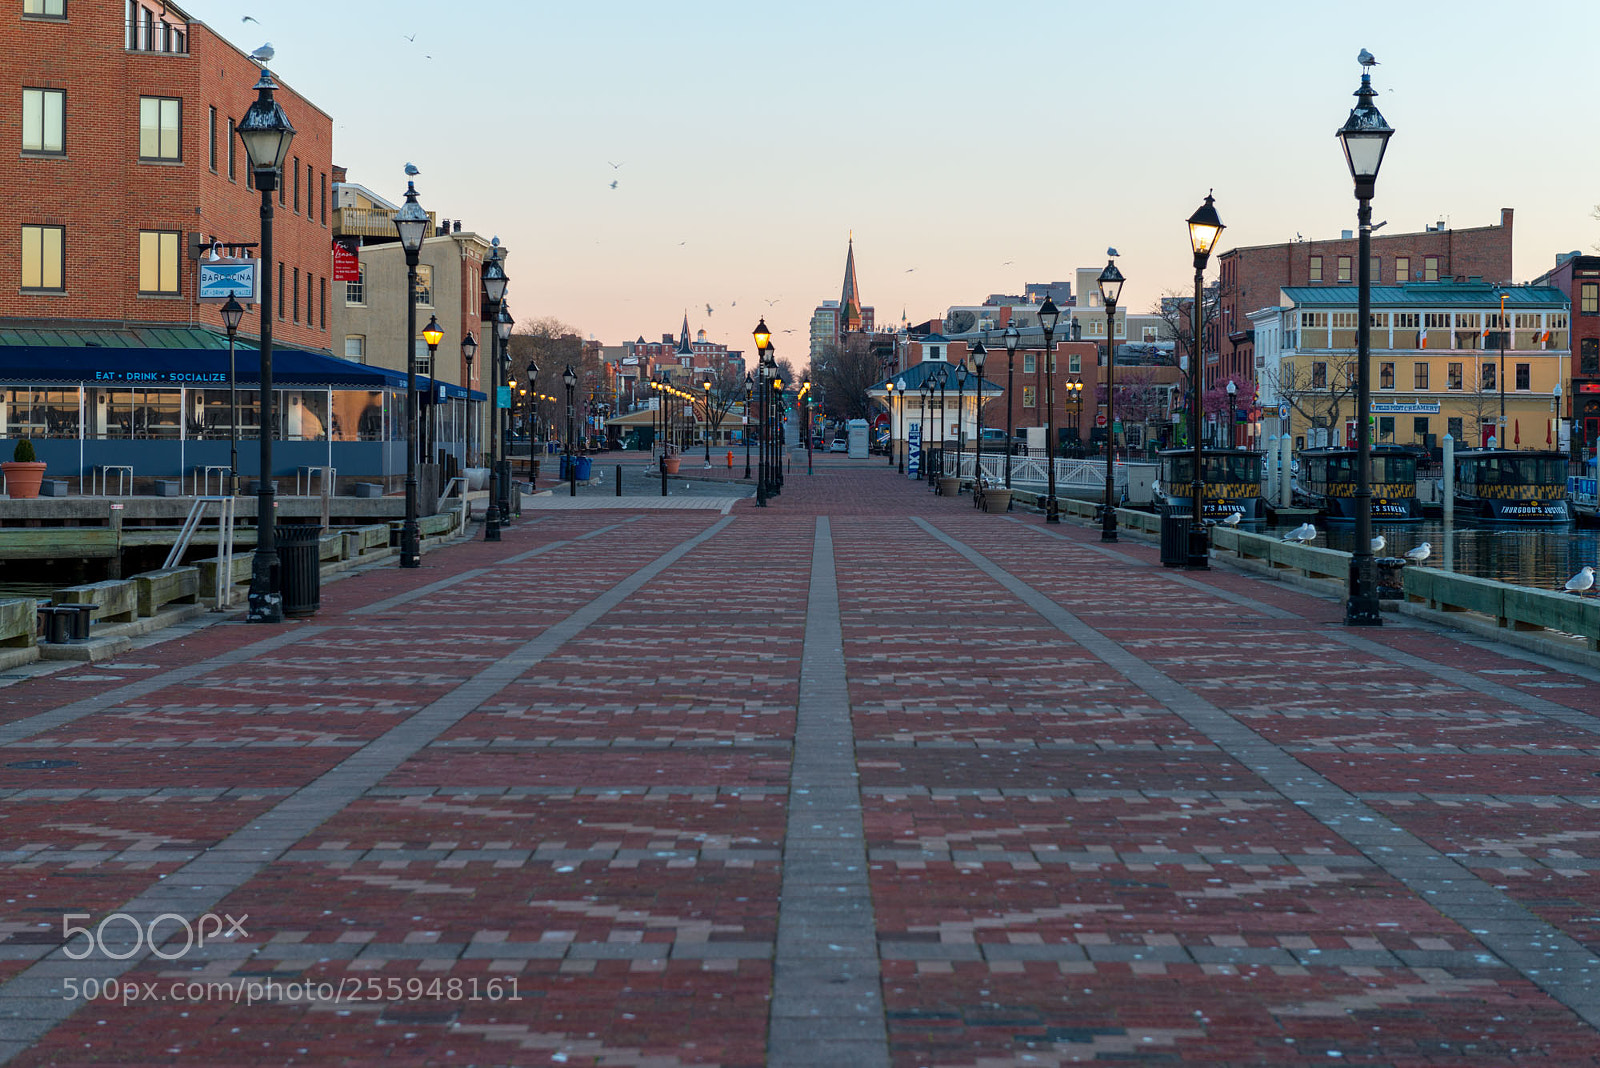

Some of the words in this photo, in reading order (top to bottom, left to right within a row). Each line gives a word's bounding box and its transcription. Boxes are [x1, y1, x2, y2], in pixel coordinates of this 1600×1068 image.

[335, 240, 349, 250] For
[201, 273, 252, 281] BARCOCINA
[95, 371, 115, 380] EAT
[126, 372, 158, 381] DRINK
[169, 373, 226, 382] SOCIALIZE
[911, 423, 919, 431] 11
[909, 436, 920, 469] TAXI
[1217, 504, 1246, 513] ANTHEM
[1382, 505, 1407, 514] STREAK
[1501, 505, 1543, 514] THURGOOD'S
[1544, 506, 1566, 514] JUSTICE
